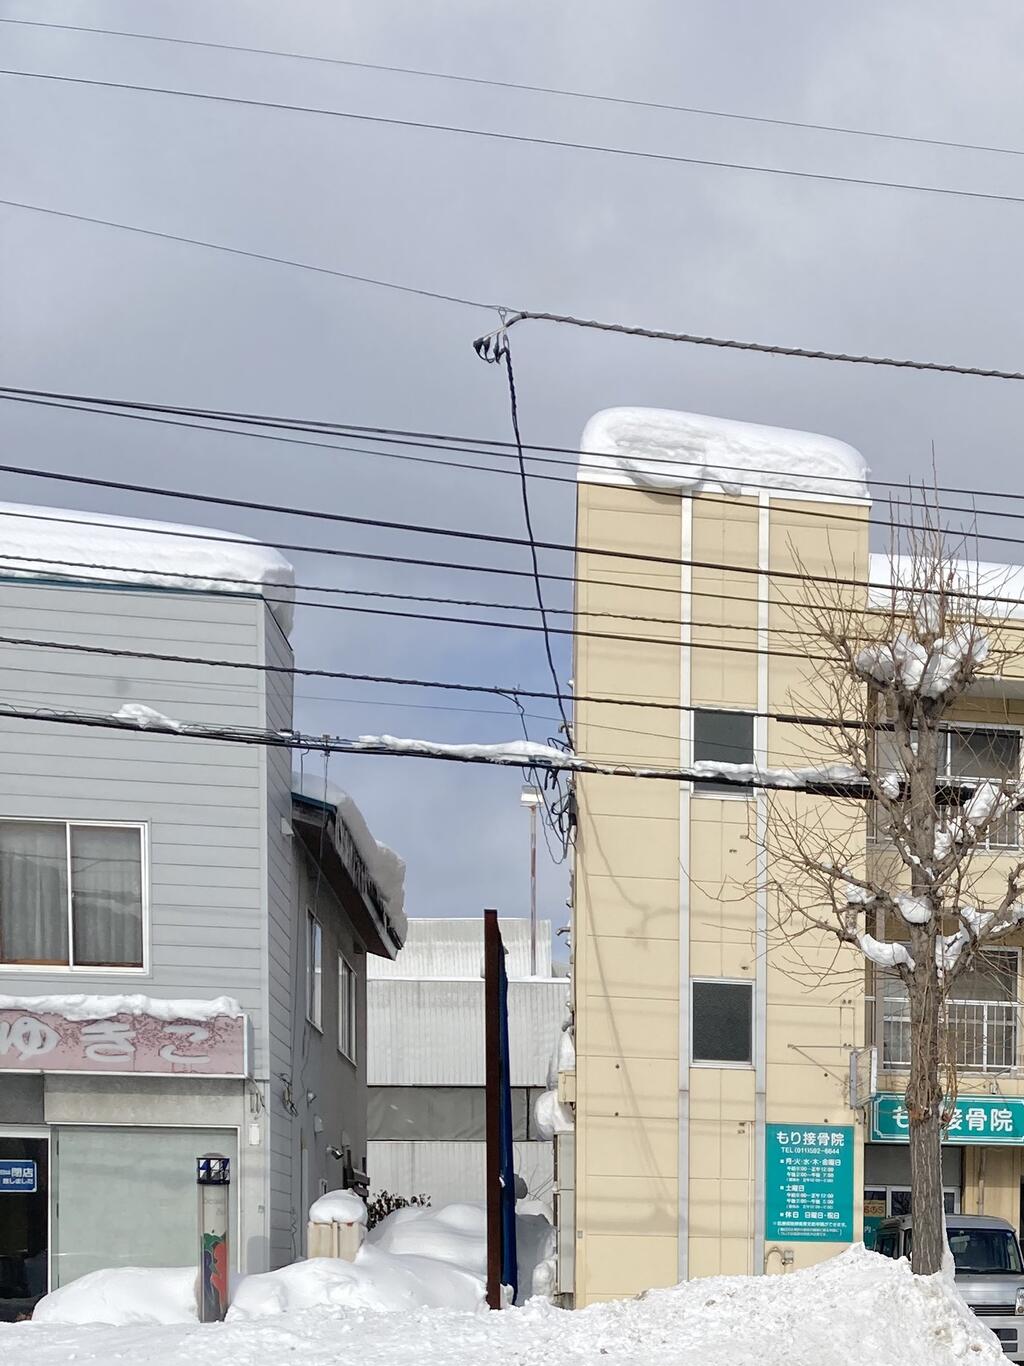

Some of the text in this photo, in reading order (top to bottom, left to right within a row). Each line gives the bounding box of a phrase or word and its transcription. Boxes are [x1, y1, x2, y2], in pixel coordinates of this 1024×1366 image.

[892, 1106, 1013, 1132] も接骨院
[776, 1131, 845, 1147] もり接骨院
